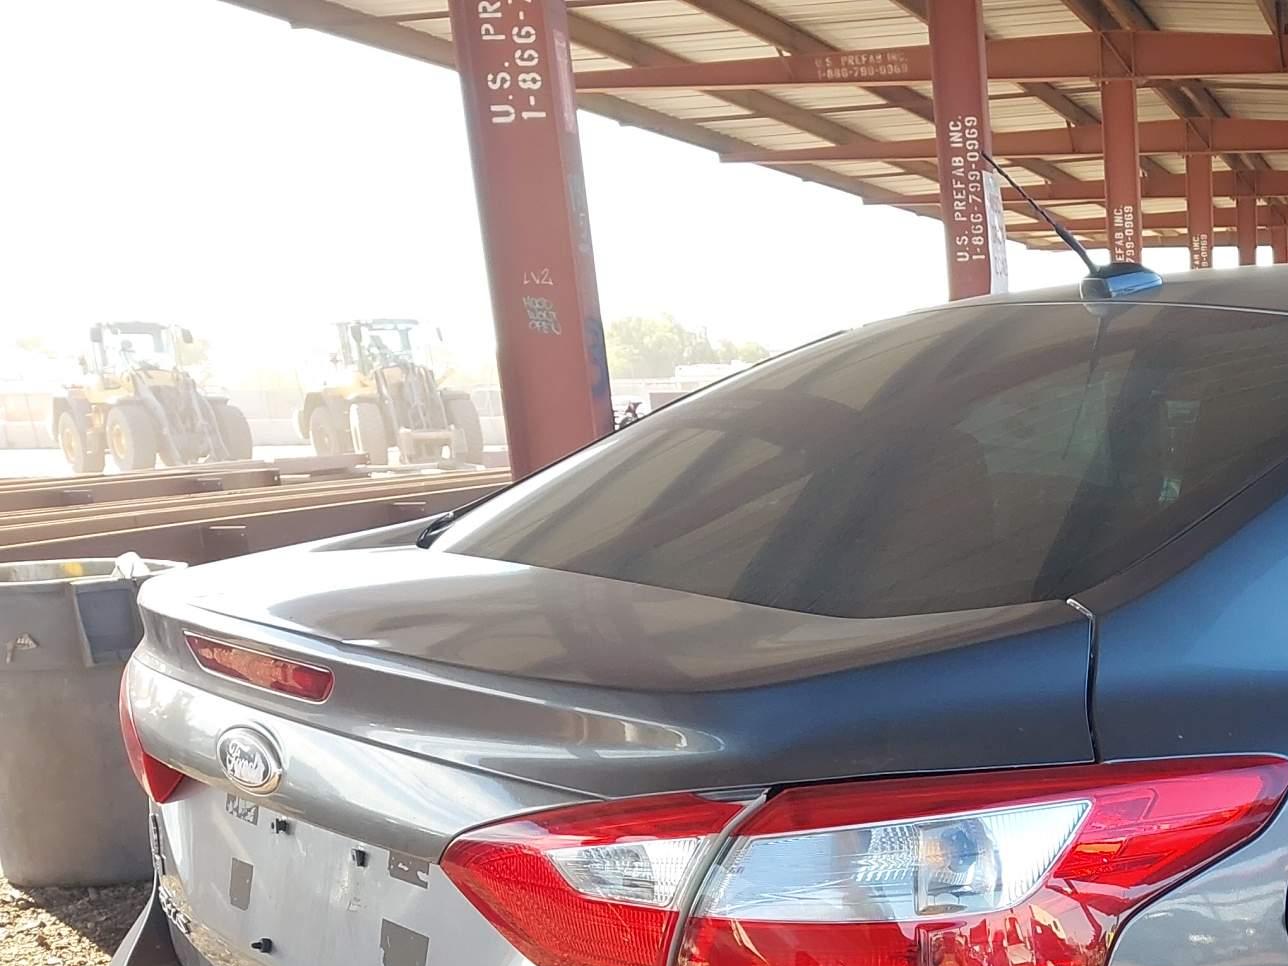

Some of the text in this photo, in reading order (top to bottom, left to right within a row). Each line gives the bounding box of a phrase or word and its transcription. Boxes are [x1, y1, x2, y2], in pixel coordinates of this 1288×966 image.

[487, 61, 516, 124] U.S.
[508, 0, 547, 120] 1-866-
[949, 115, 970, 262] U.S. PREFAB INC.
[964, 116, 986, 260] 1-866-799-0969
